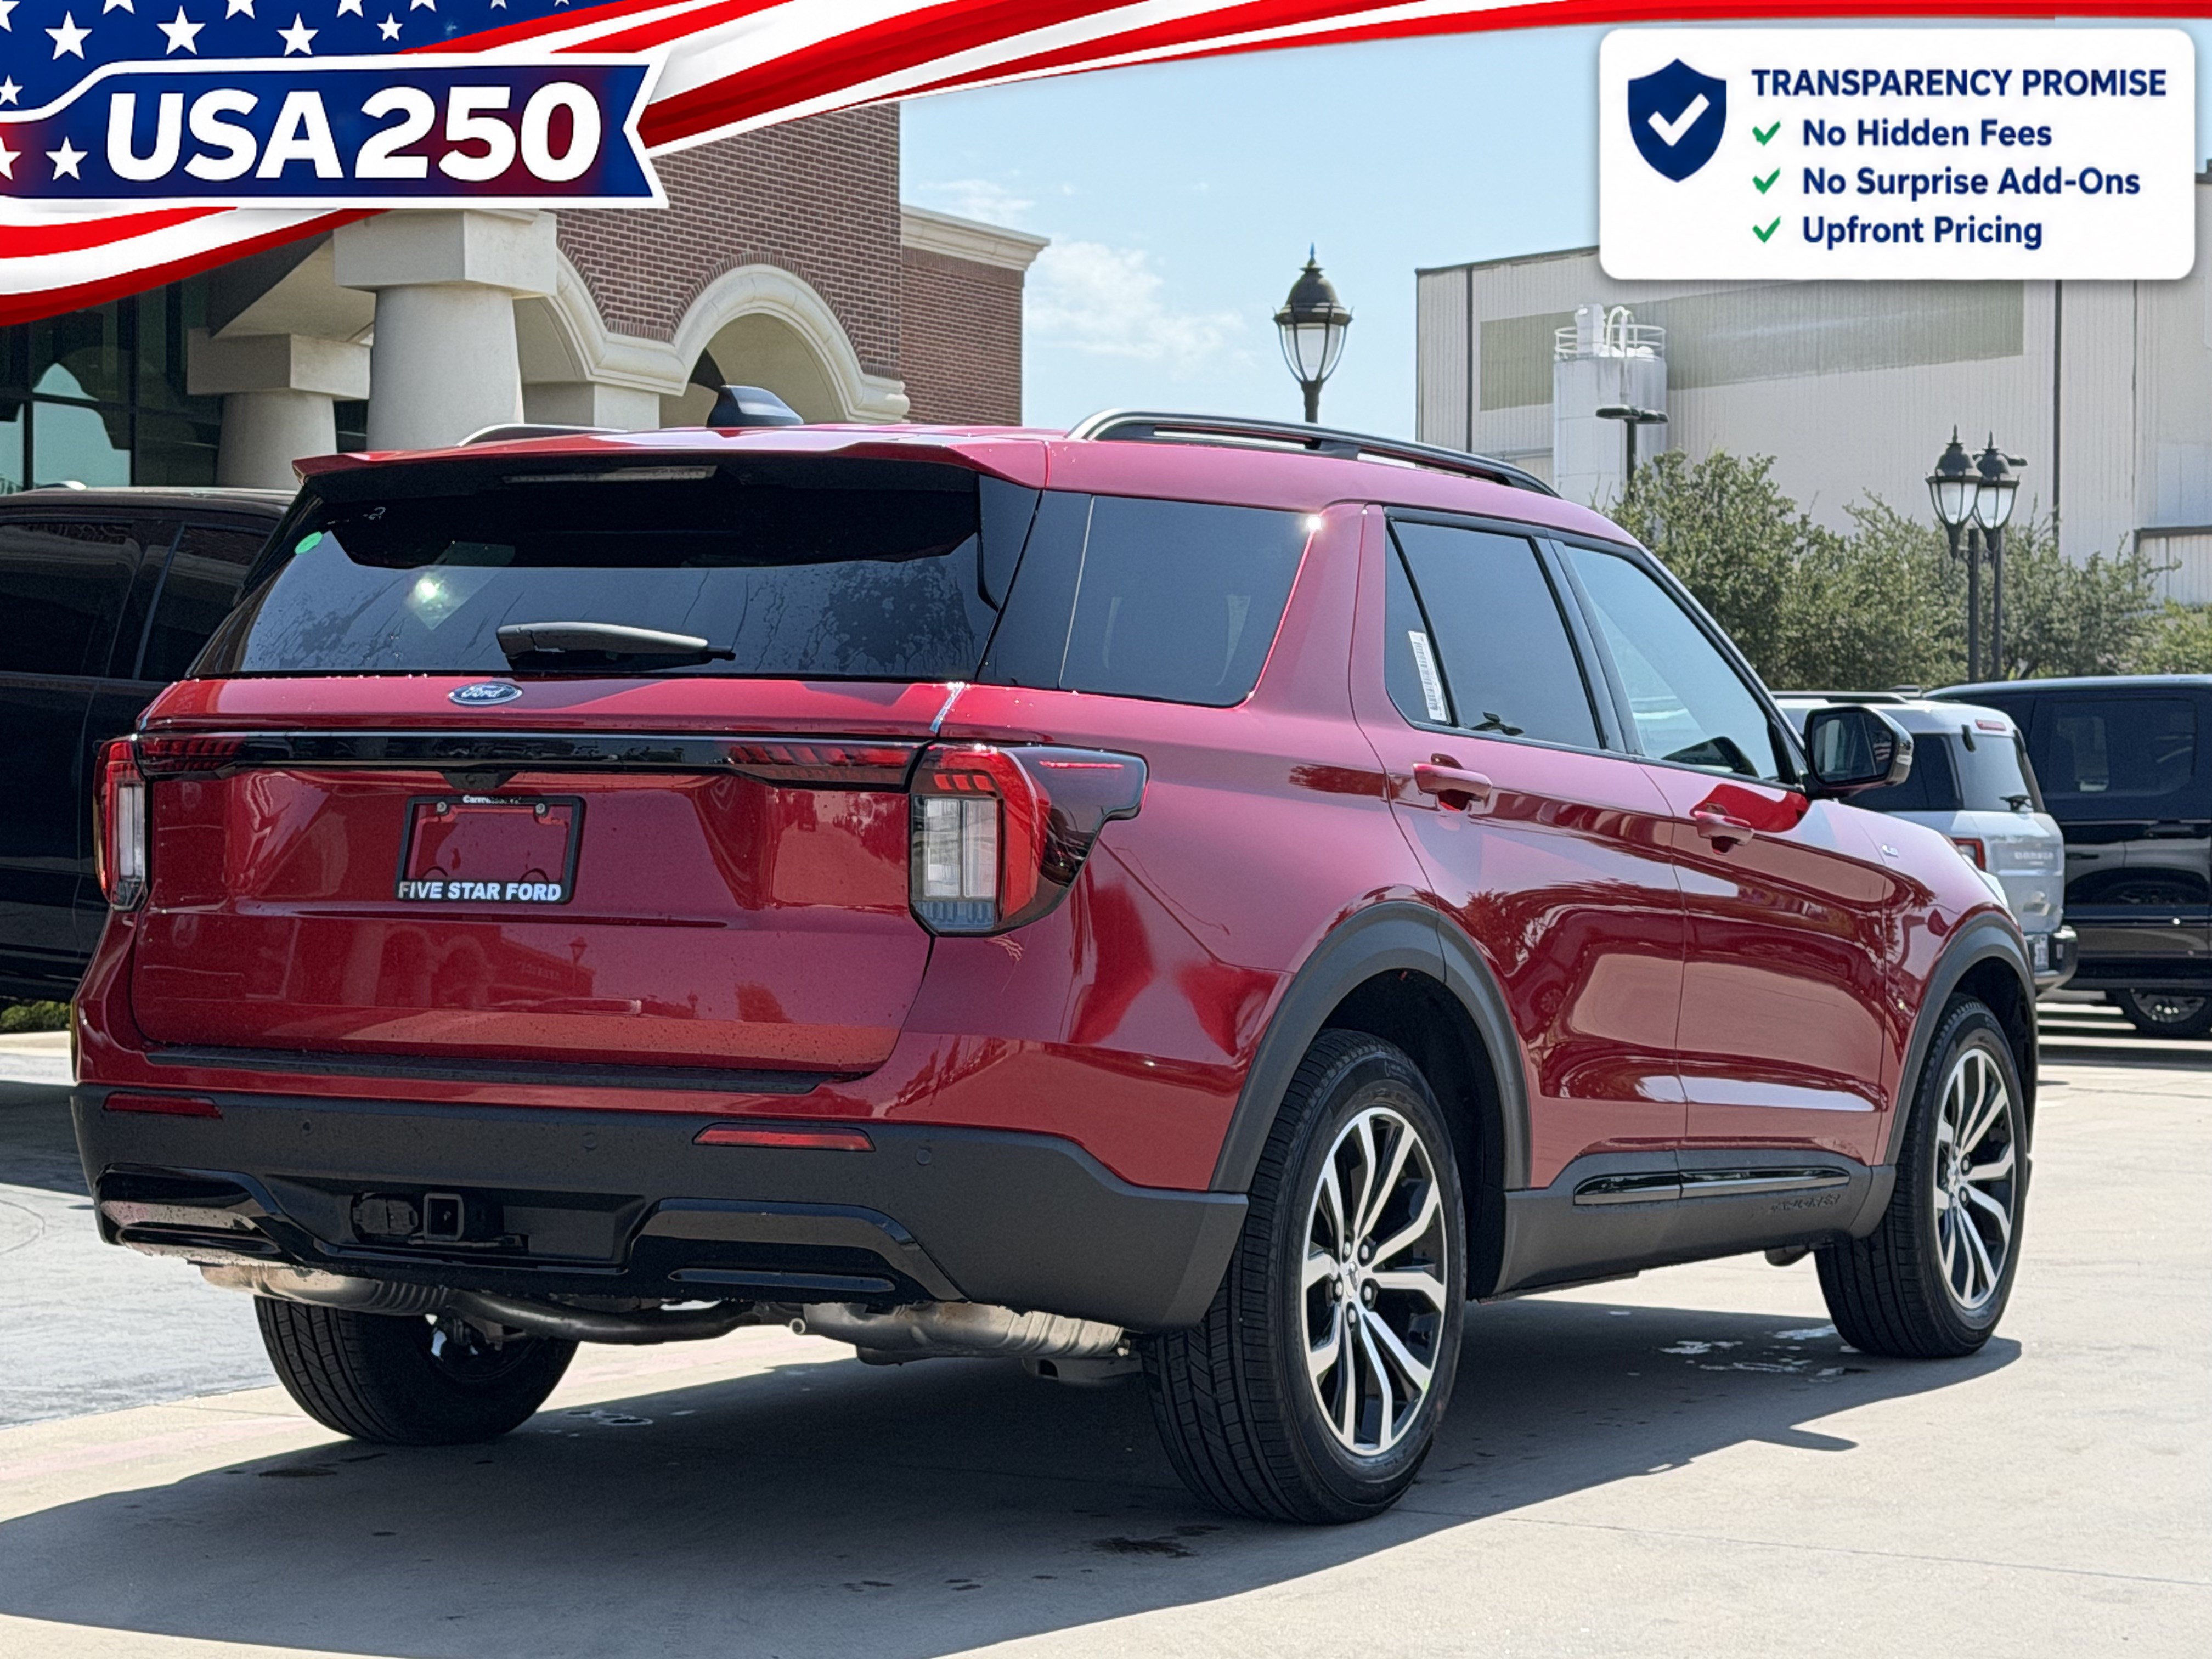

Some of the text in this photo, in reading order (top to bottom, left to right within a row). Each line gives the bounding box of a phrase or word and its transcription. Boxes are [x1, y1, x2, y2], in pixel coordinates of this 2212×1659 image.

[461, 685, 504, 698] Ford
[398, 881, 562, 901] FIVE STAR FORD
